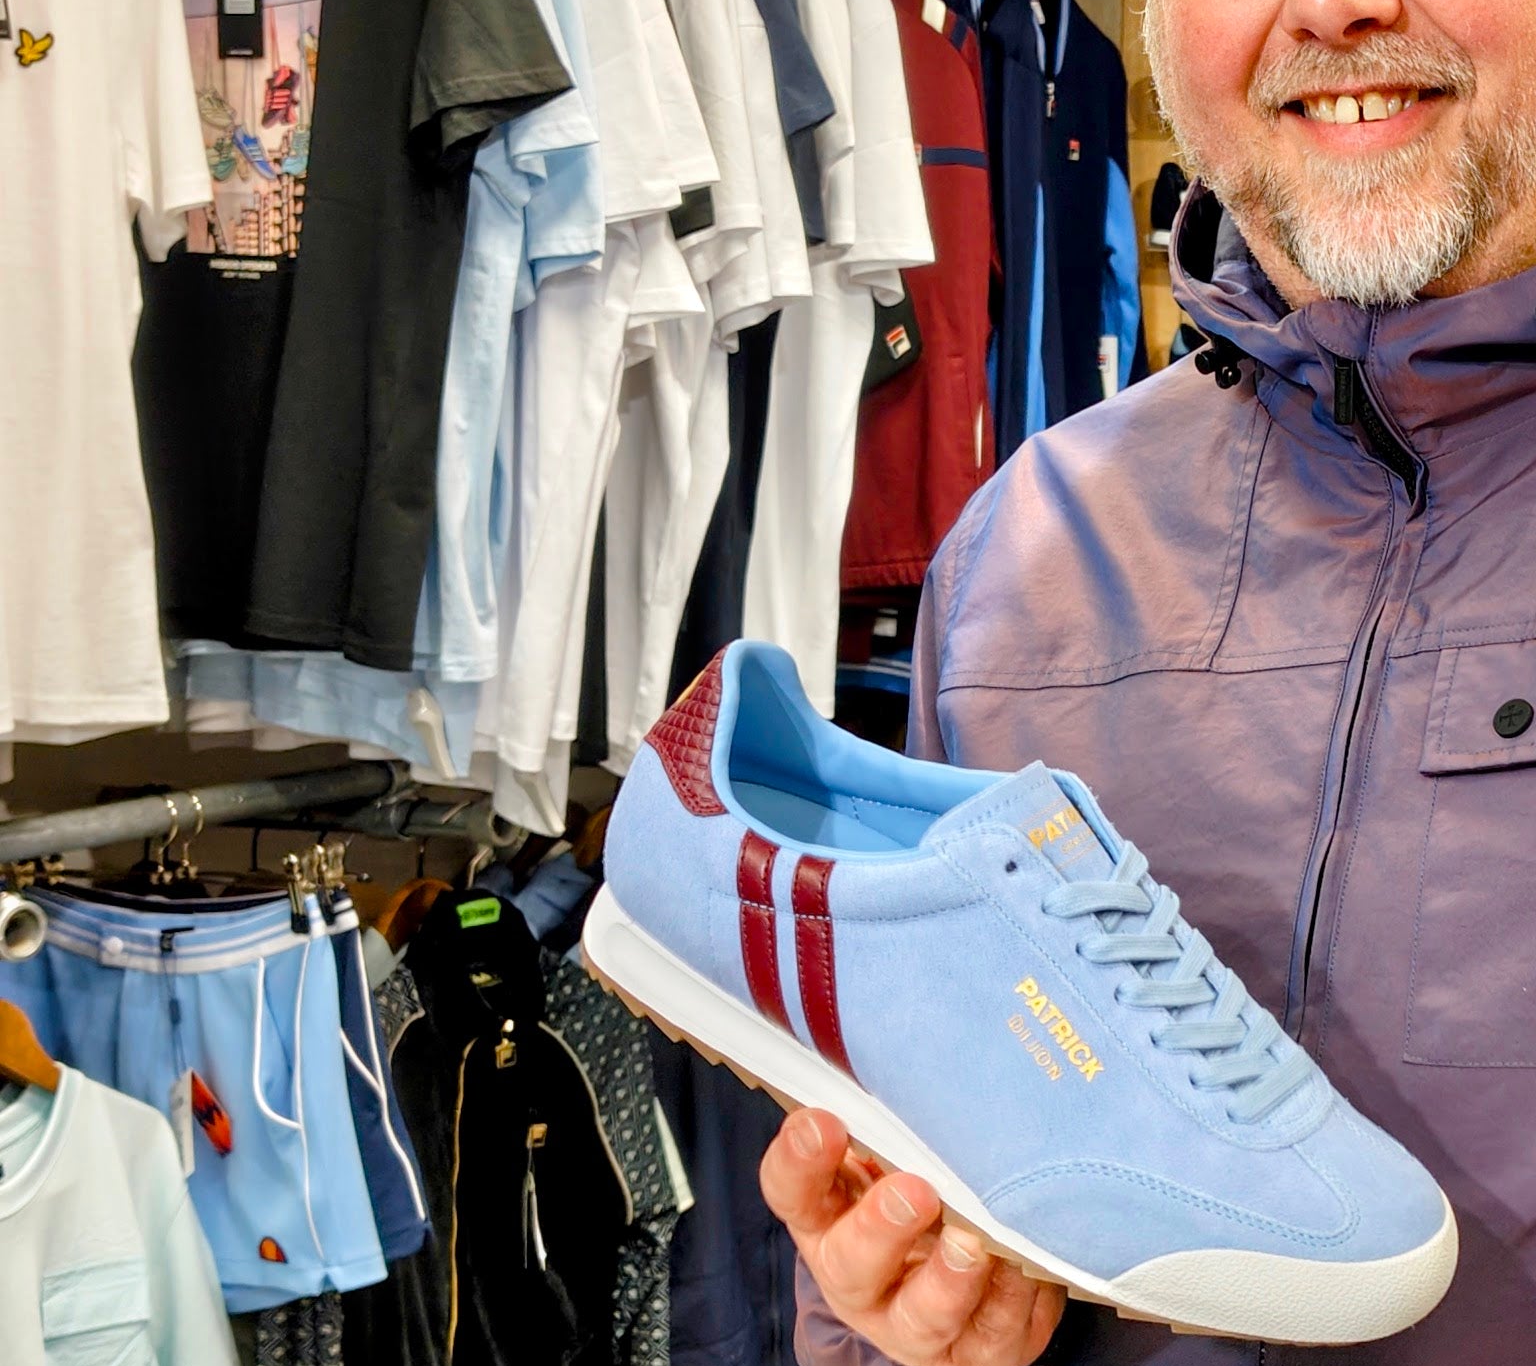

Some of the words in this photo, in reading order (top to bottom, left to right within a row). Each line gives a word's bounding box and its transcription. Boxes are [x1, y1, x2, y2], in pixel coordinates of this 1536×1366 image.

[1028, 805, 1081, 851] PATR
[1007, 1014, 1062, 1082] DIJON
[1014, 976, 1105, 1084] PATRICK
